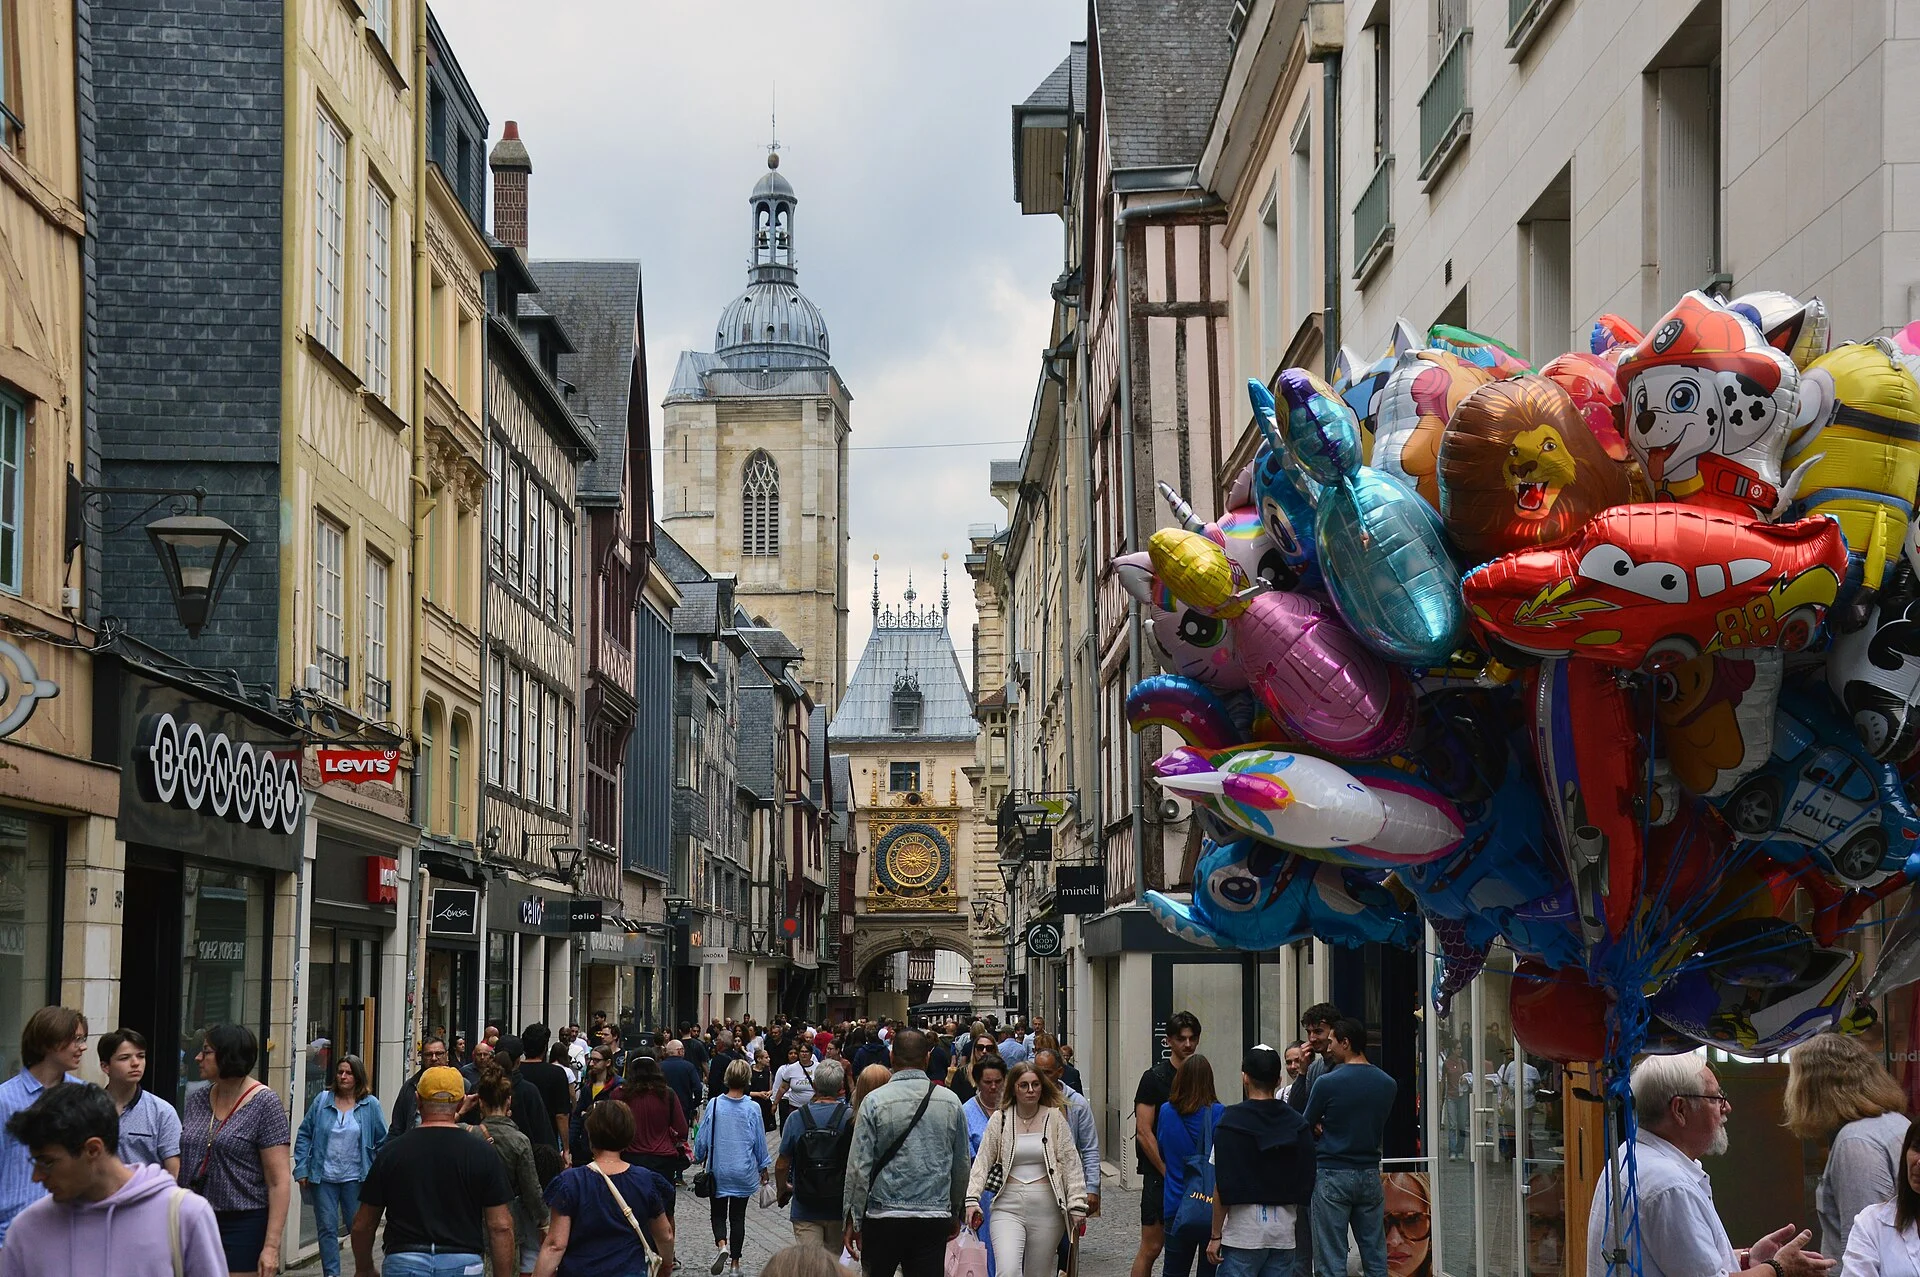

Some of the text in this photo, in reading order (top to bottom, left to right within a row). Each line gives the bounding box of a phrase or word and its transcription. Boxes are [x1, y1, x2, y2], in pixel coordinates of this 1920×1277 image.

[1714, 594, 1778, 649] 88
[155, 721, 301, 829] BONOBO
[1792, 799, 1849, 830] POLICE
[1061, 884, 1099, 896] minelli
[435, 902, 471, 921] Lovisa
